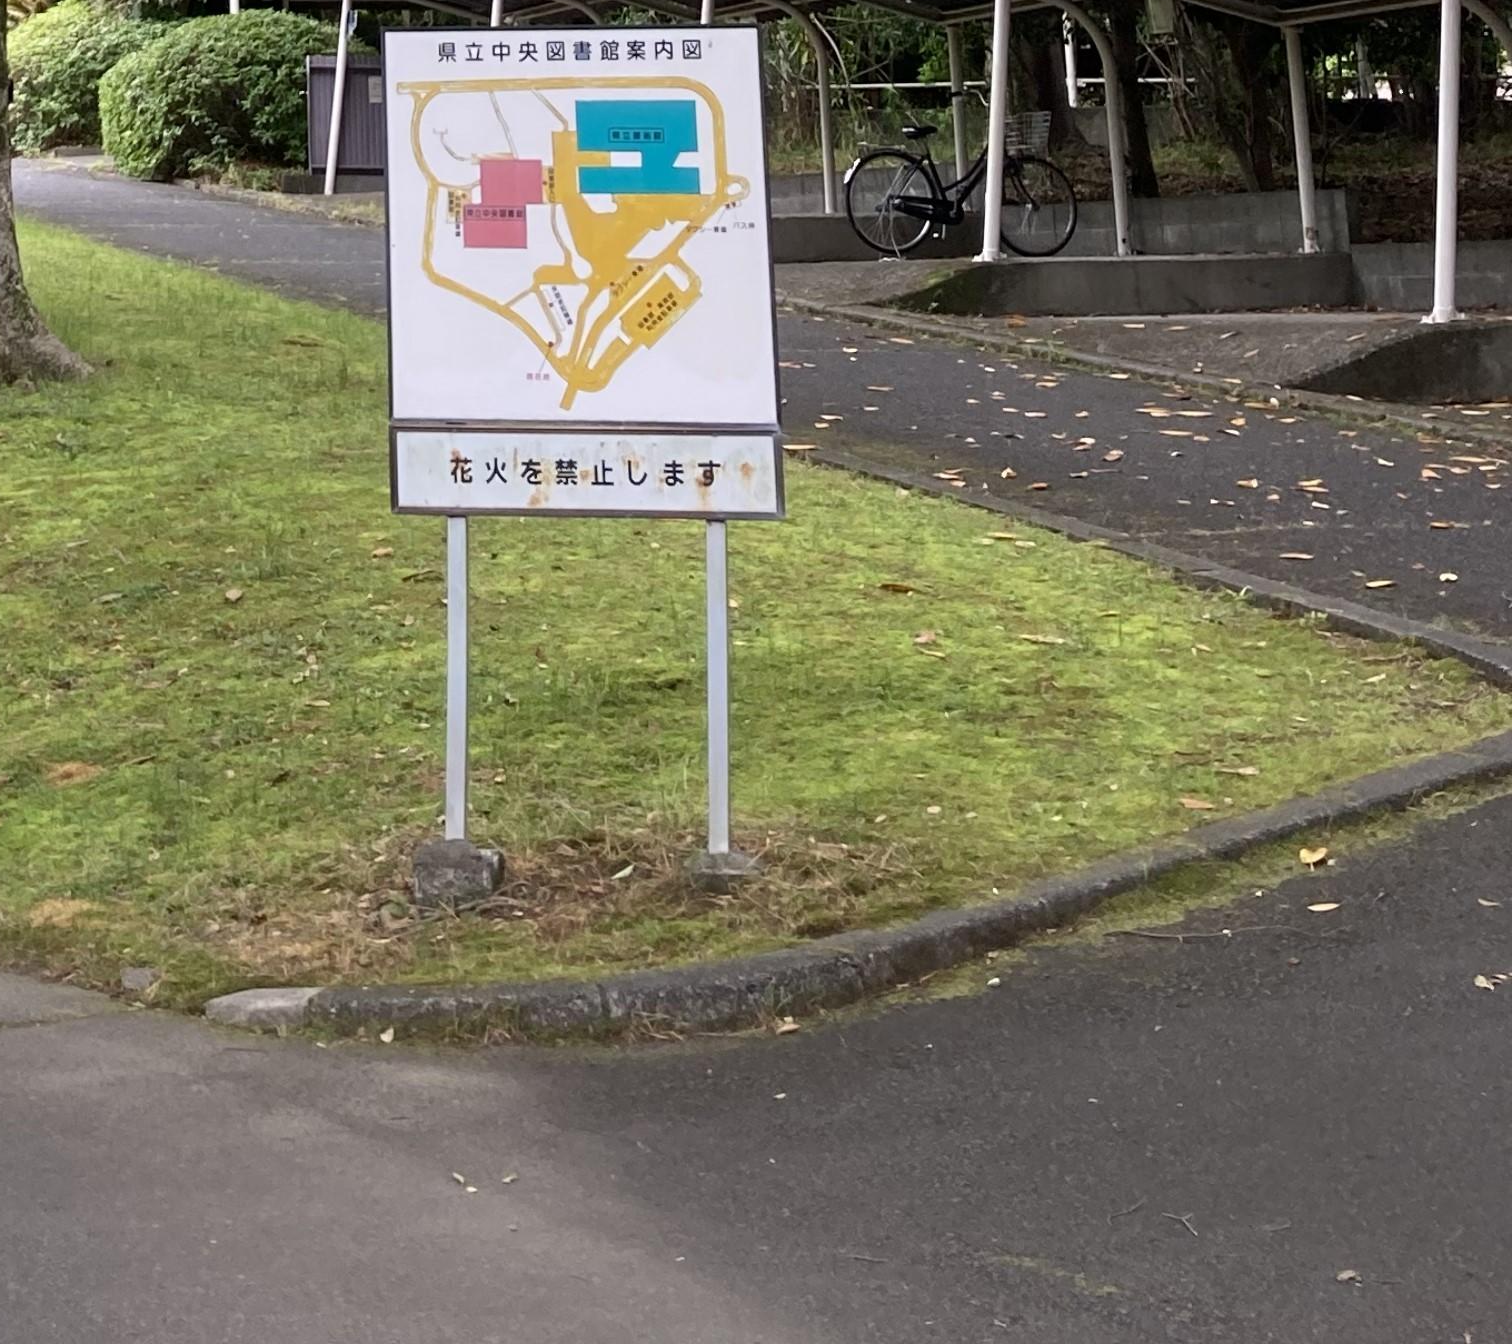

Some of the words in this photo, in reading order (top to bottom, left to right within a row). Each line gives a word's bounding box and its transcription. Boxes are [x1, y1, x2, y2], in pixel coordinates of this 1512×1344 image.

[438, 39, 702, 62] 県立中央図書館案内図
[450, 457, 721, 486] 花火を禁止します
